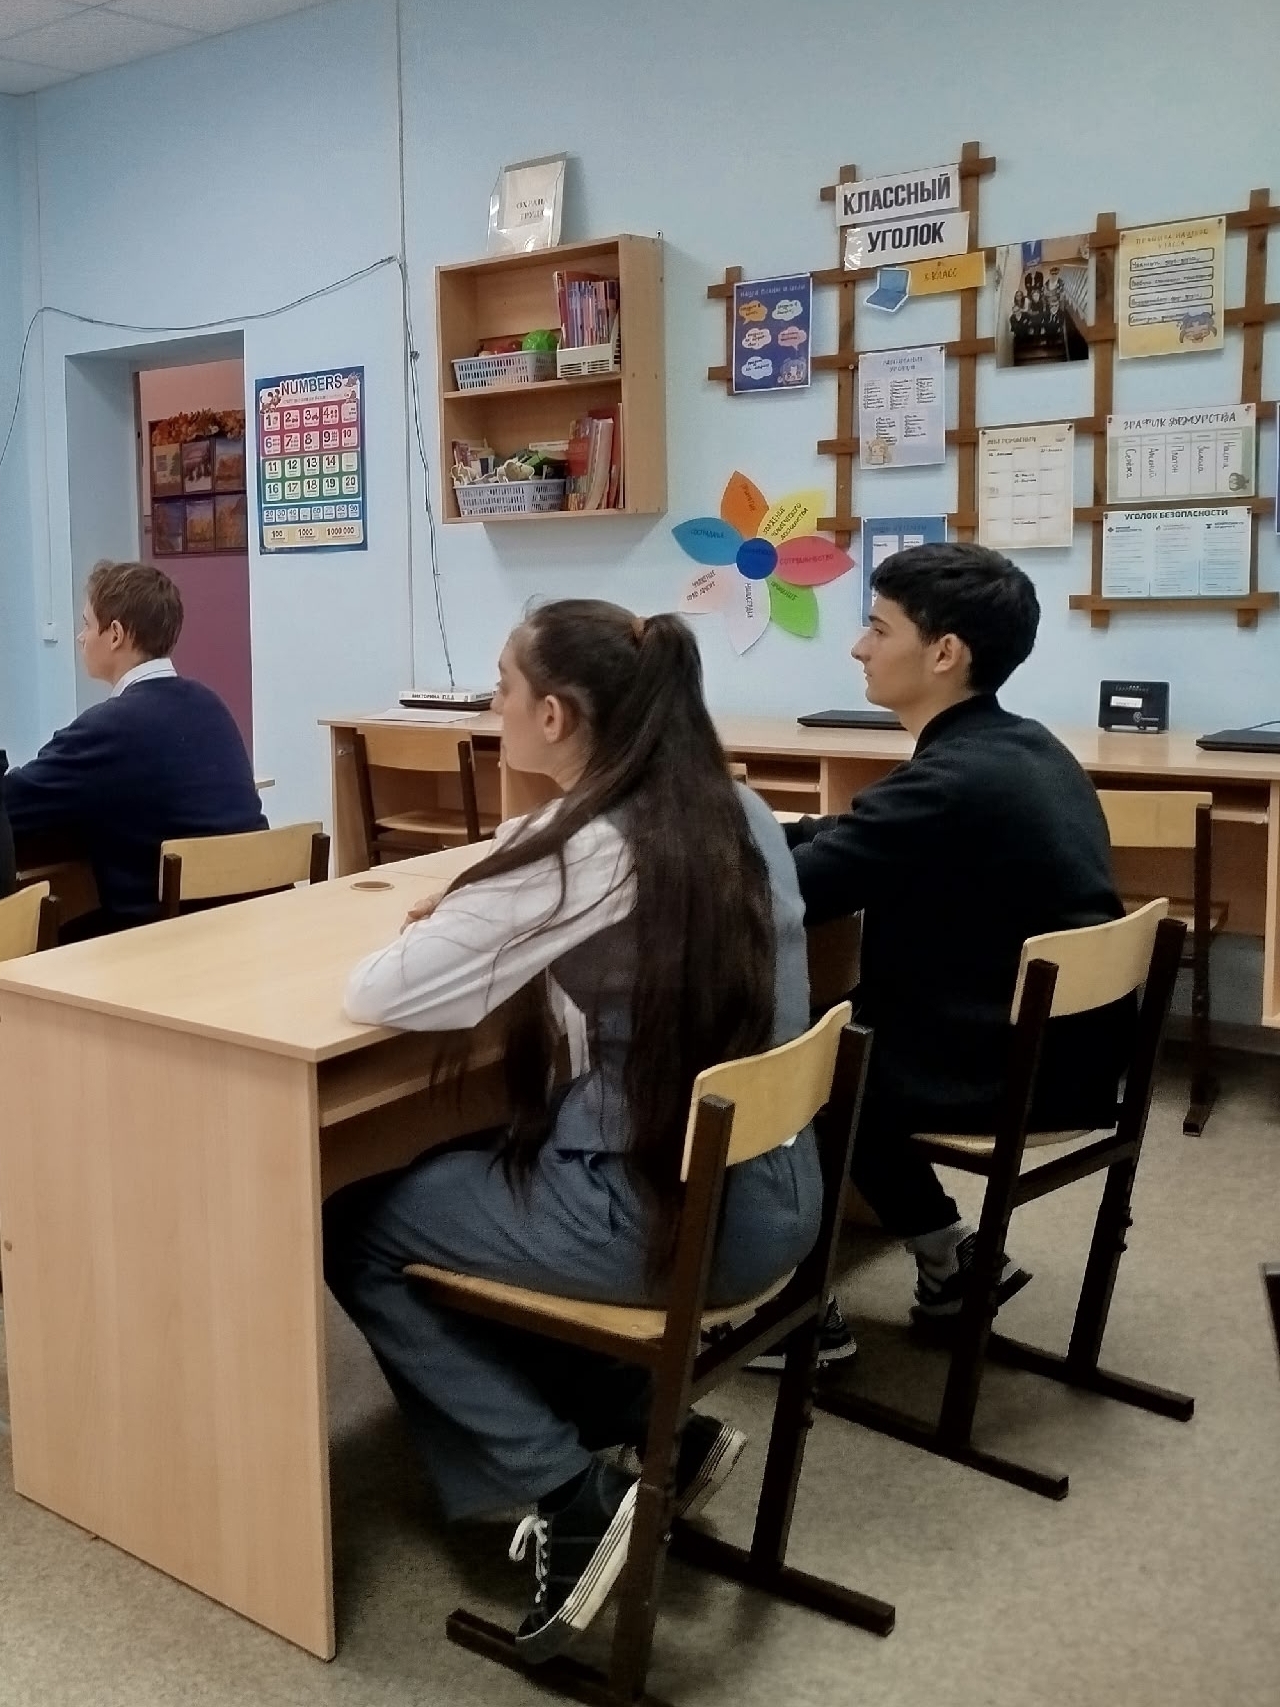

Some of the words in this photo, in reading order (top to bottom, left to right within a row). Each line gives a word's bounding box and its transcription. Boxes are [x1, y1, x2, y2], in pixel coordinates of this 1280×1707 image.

[843, 172, 951, 216] КЛАССНЫЙ
[867, 221, 946, 253] УГОЛОК
[279, 373, 343, 396] NUMBERS
[304, 410, 311, 421] 3
[324, 408, 330, 418] 4
[265, 437, 272, 448] 6
[285, 435, 293, 447] 7
[304, 434, 312, 445] 8
[324, 430, 330, 442] 9
[342, 429, 352, 438] 10
[268, 462, 278, 472] 11
[287, 460, 298, 470] 12
[306, 457, 318, 468] 13
[325, 455, 336, 466] 14
[268, 483, 278, 494] 16
[287, 482, 298, 493] 17
[306, 480, 318, 490] 18
[325, 478, 336, 488] 19
[345, 476, 356, 486] 20
[1124, 511, 1158, 521] УГОЛОК
[1159, 508, 1229, 519] БЕЗОПАСНОСТИ
